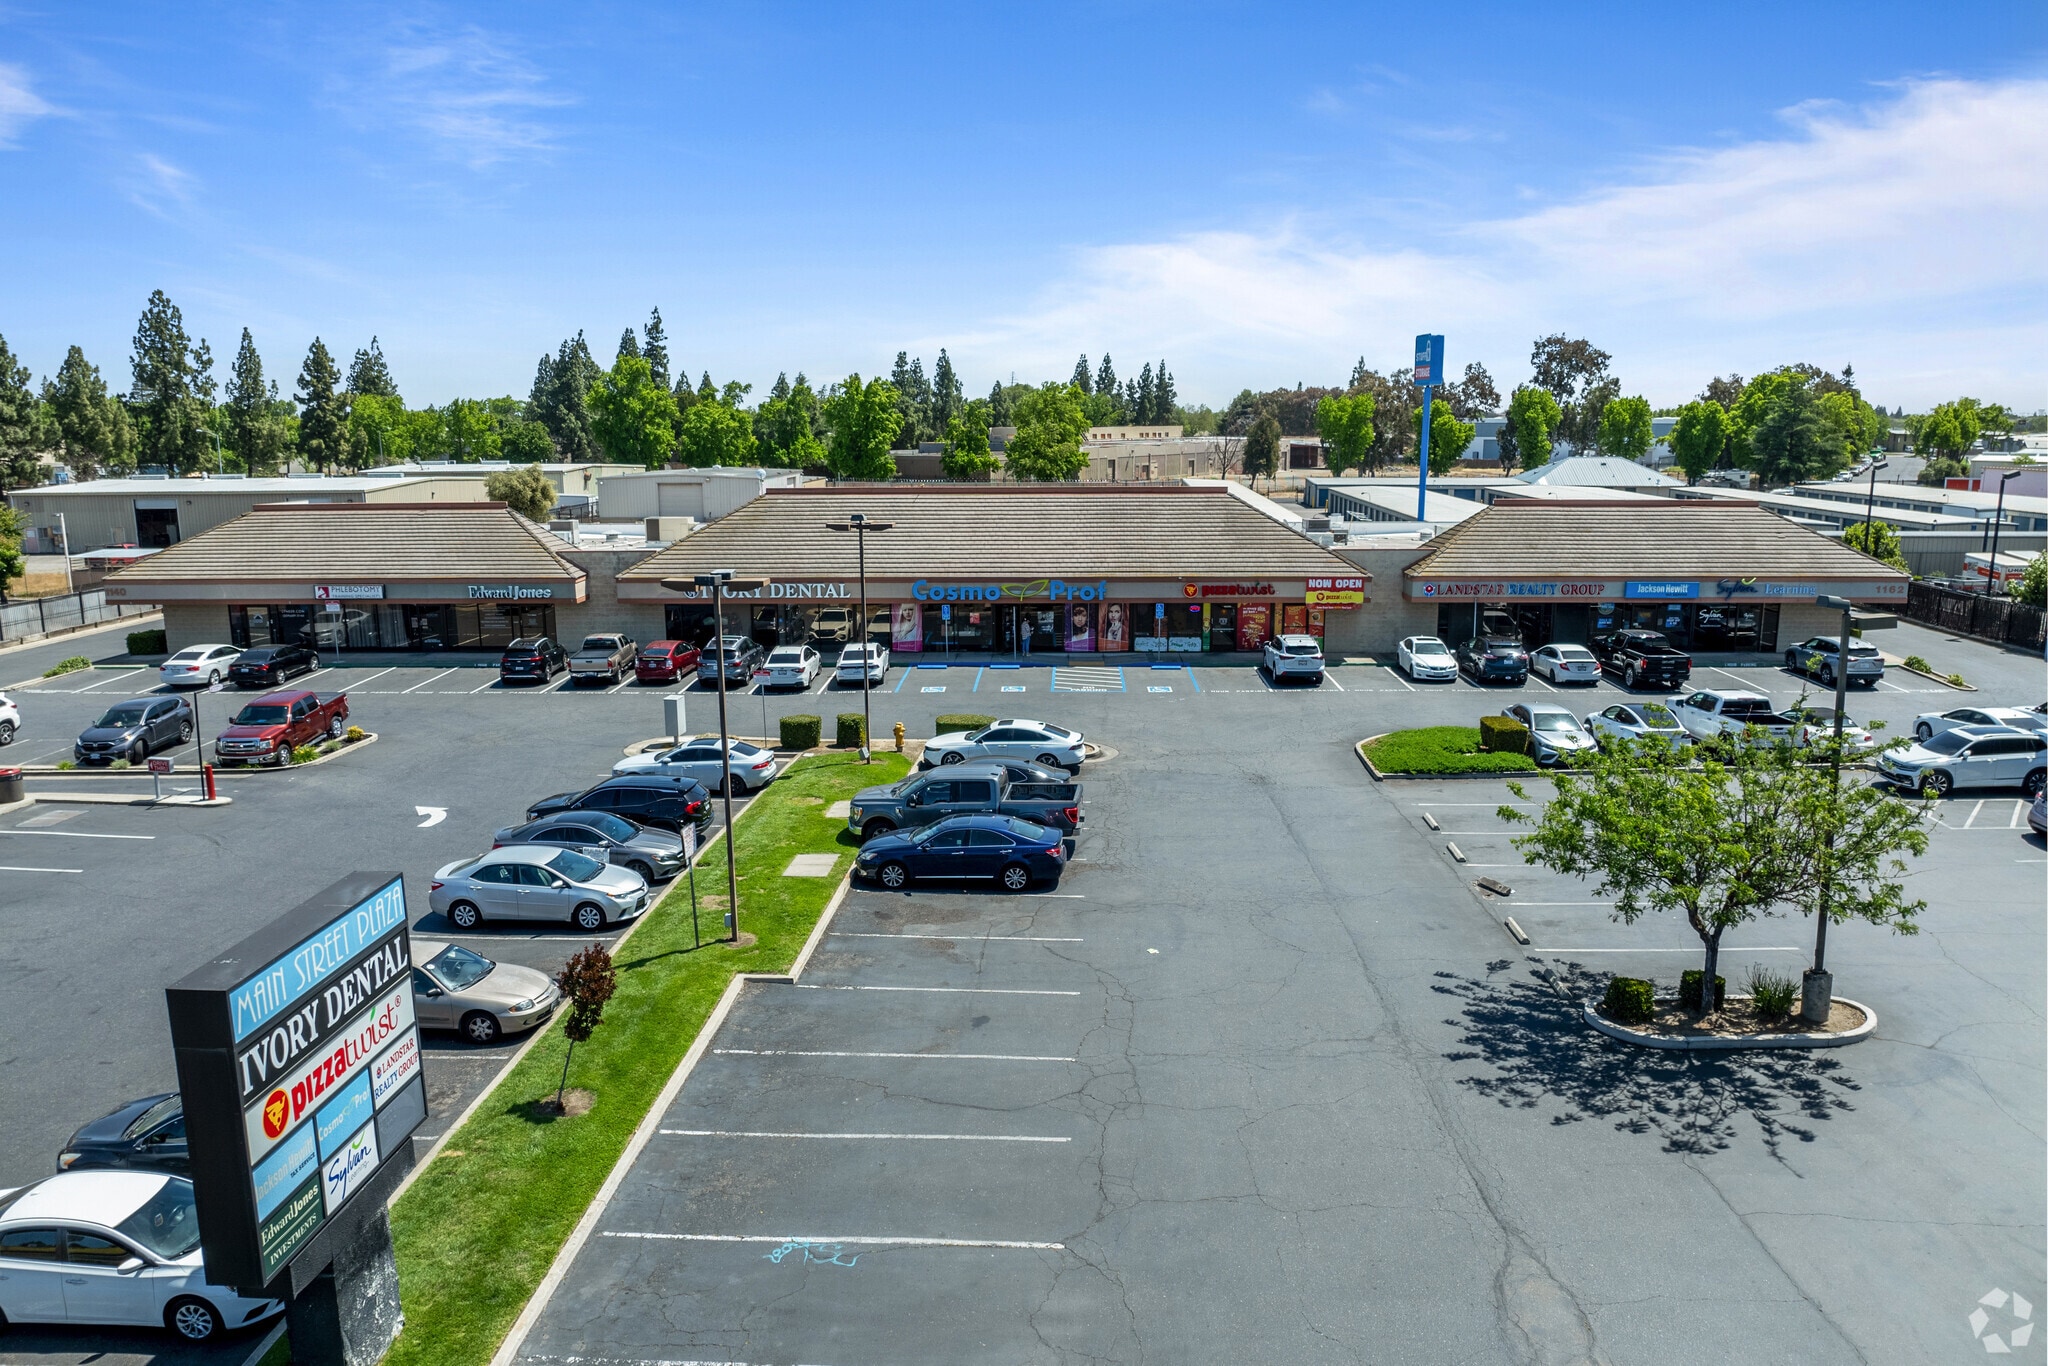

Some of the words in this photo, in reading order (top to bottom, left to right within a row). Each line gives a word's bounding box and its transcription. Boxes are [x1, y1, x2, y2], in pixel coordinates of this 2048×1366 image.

[769, 583, 851, 598] DENTAL
[911, 579, 1000, 601] Cosmo
[1049, 579, 1108, 601] Prof
[1201, 581, 1276, 597] pizzatwist
[1308, 578, 1332, 588] NOW
[1335, 578, 1362, 588] OPEN
[1436, 584, 1505, 596] LANDSTAR
[1508, 583, 1557, 596] REALTY
[1560, 583, 1605, 596] GROUP
[1637, 584, 1665, 593] Jackson
[1665, 583, 1689, 593] Hewitt
[1716, 579, 1758, 601] Sylvan
[1765, 583, 1817, 595] Learning
[1875, 585, 1904, 594] 1162
[1699, 609, 1724, 623] Sylvan
[237, 966, 287, 1034] MAIN
[294, 921, 350, 991] STREET
[356, 886, 403, 944] PLAZA
[239, 999, 319, 1096] IVORY
[324, 936, 408, 1028] DENTAL
[382, 1037, 415, 1074] LANDSTAR
[374, 1069, 399, 1099] REALTY
[398, 1051, 419, 1077] GROUP
[318, 1113, 344, 1141] Cosmo
[354, 1083, 371, 1109] Prof
[290, 1168, 299, 1178] TAX
[298, 1151, 316, 1171] SERVICE
[328, 1146, 372, 1200] Sylvan
[270, 1213, 317, 1266] INVESTMENTS
